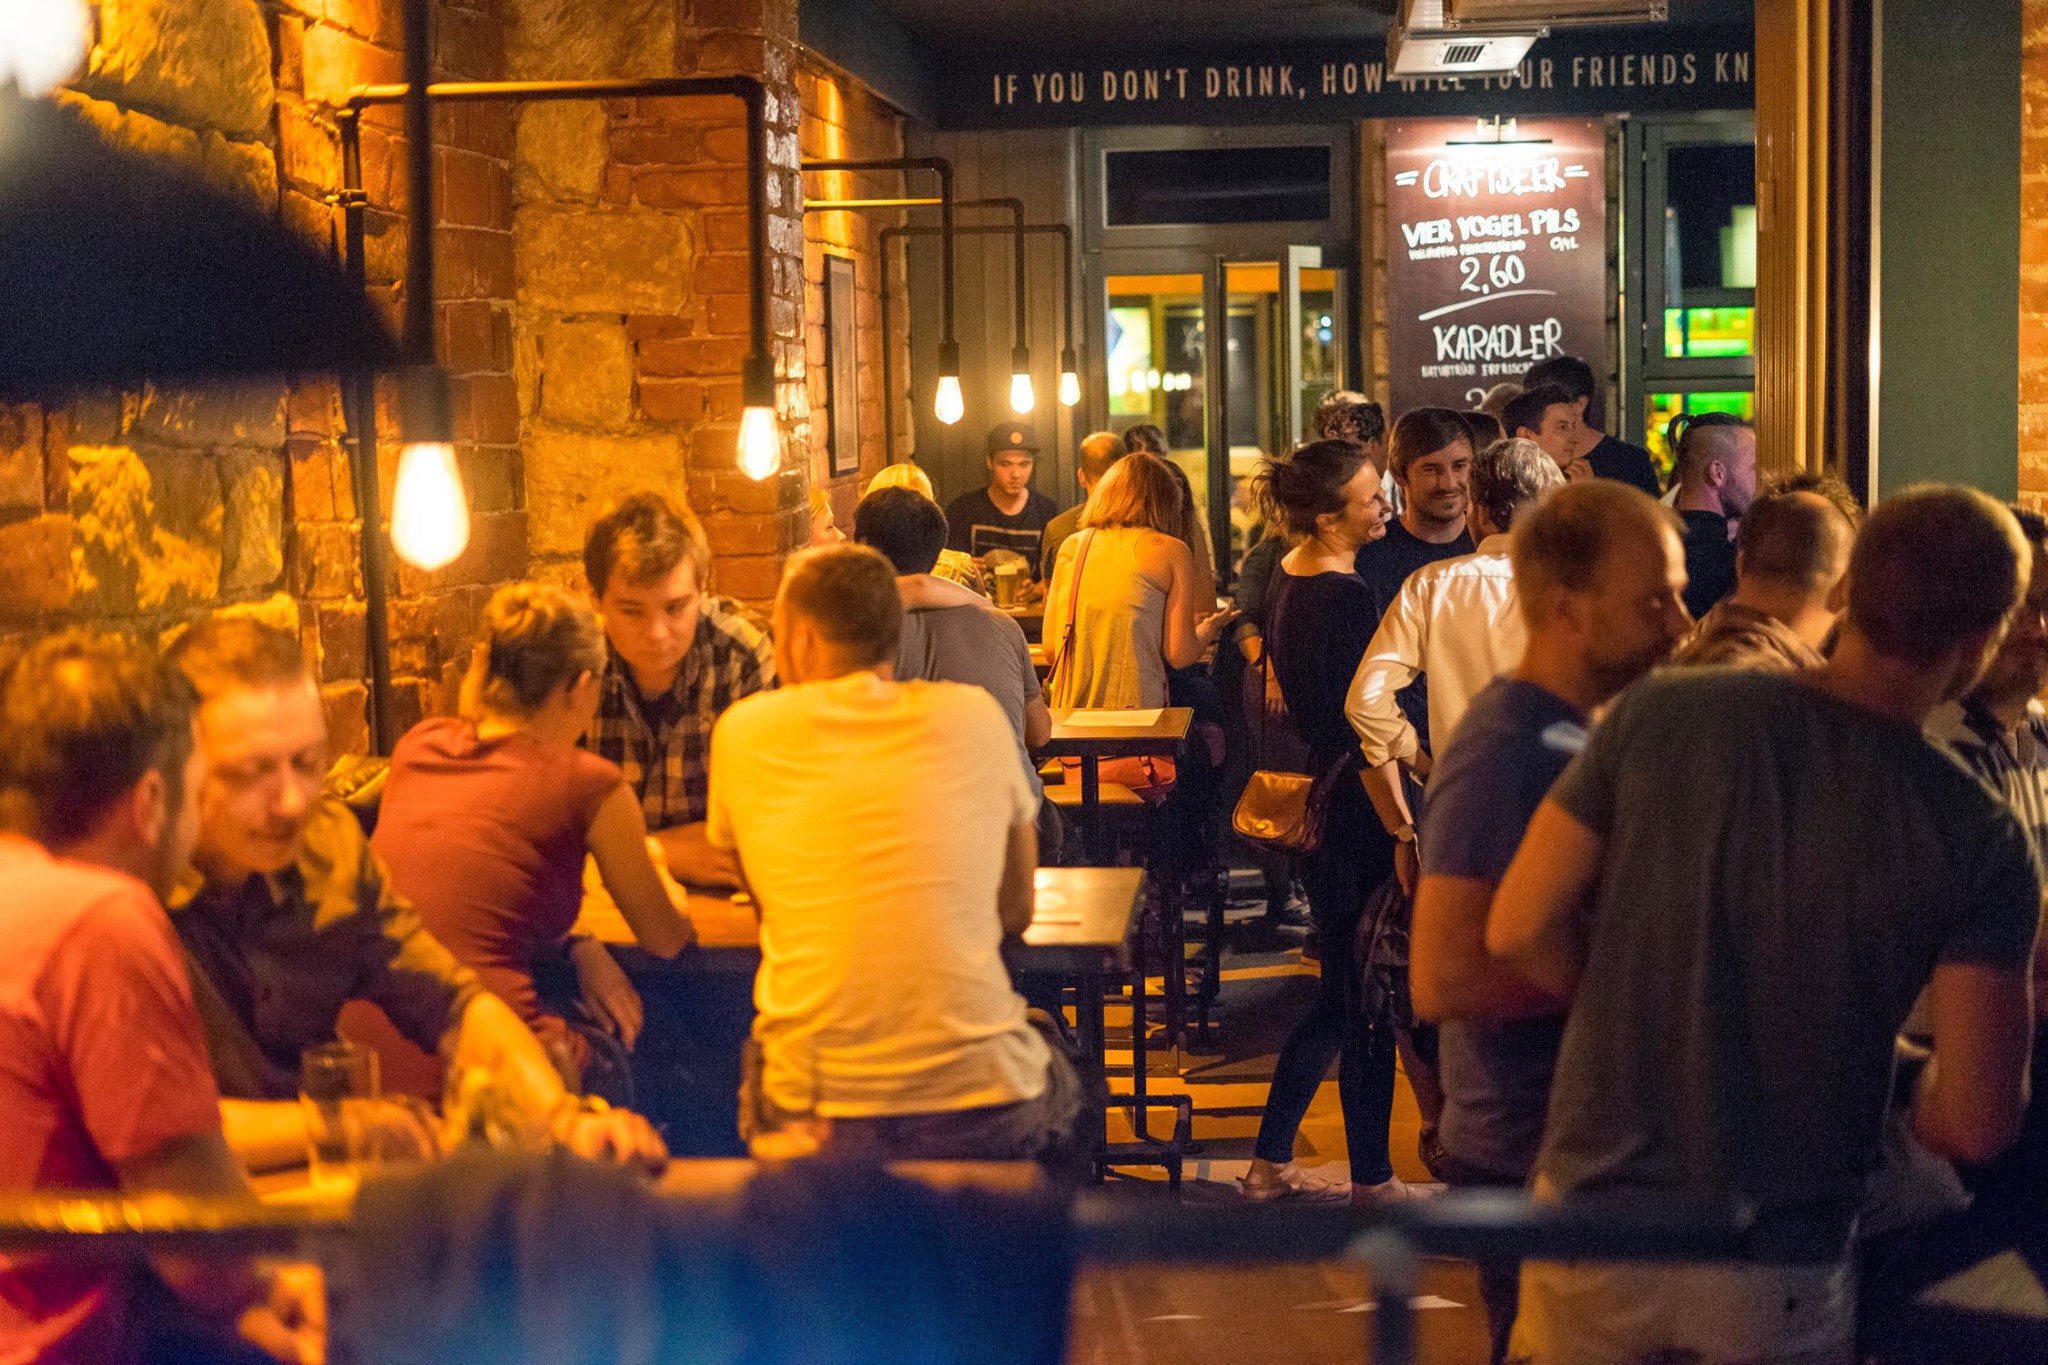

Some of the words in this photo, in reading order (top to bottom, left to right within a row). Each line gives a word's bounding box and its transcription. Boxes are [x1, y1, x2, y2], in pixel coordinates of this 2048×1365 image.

[993, 74, 1018, 105] IF
[1032, 72, 1084, 103] YOU
[1103, 68, 1188, 101] DON'T
[1205, 66, 1305, 100] DRINK,
[1322, 62, 1383, 95] HOW
[1573, 52, 1697, 88] FRIENDS
[1423, 157, 1566, 199] CRAFTBEER
[1401, 218, 1454, 248] VIER
[1457, 213, 1529, 241] VOGEL
[1529, 208, 1580, 235] PILS
[1459, 254, 1526, 294] 2,60
[1433, 317, 1566, 361] KARADLER
